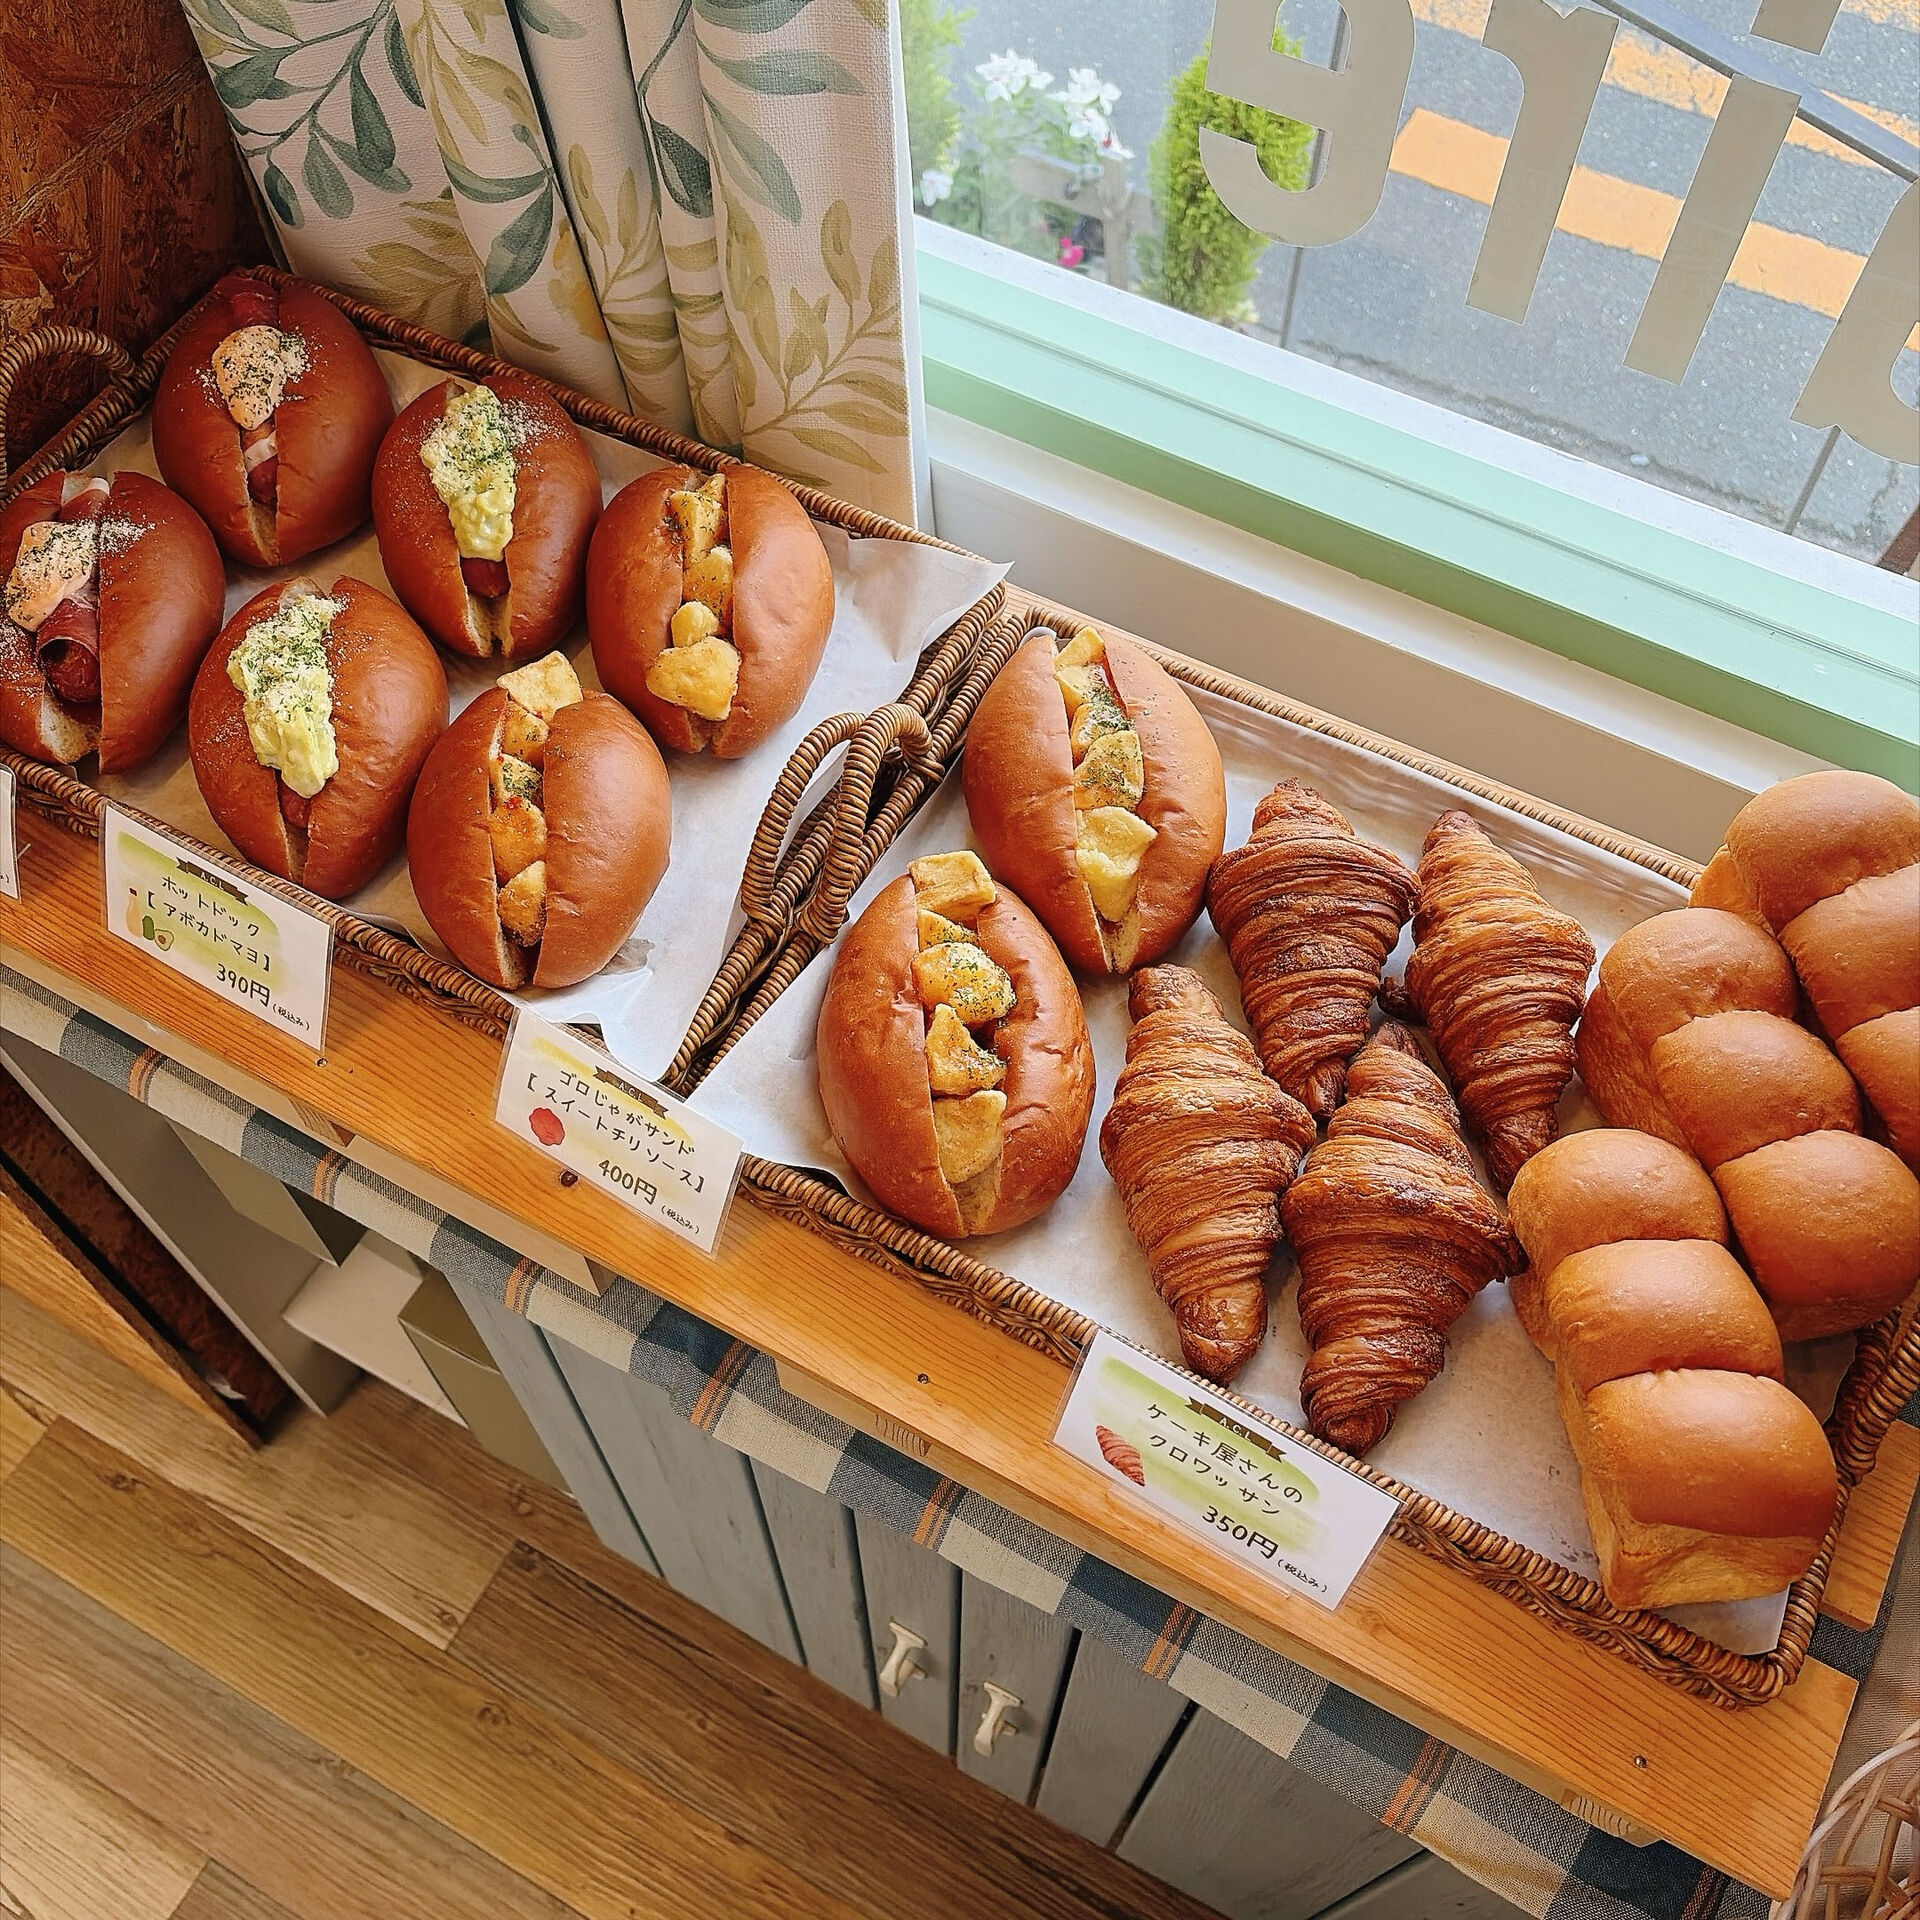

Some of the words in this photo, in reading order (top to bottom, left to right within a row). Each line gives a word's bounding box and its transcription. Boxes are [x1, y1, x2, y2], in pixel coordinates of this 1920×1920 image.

[161, 875, 260, 937] ホットドック
[216, 963, 271, 1008] 390円
[559, 1069, 696, 1156] ゴロじゃがサンド
[598, 1159, 658, 1205] 400円
[1147, 1404, 1304, 1504] ケーキ屋さんの
[1149, 1433, 1281, 1515] クロワッサン
[1202, 1505, 1279, 1559] 350円
